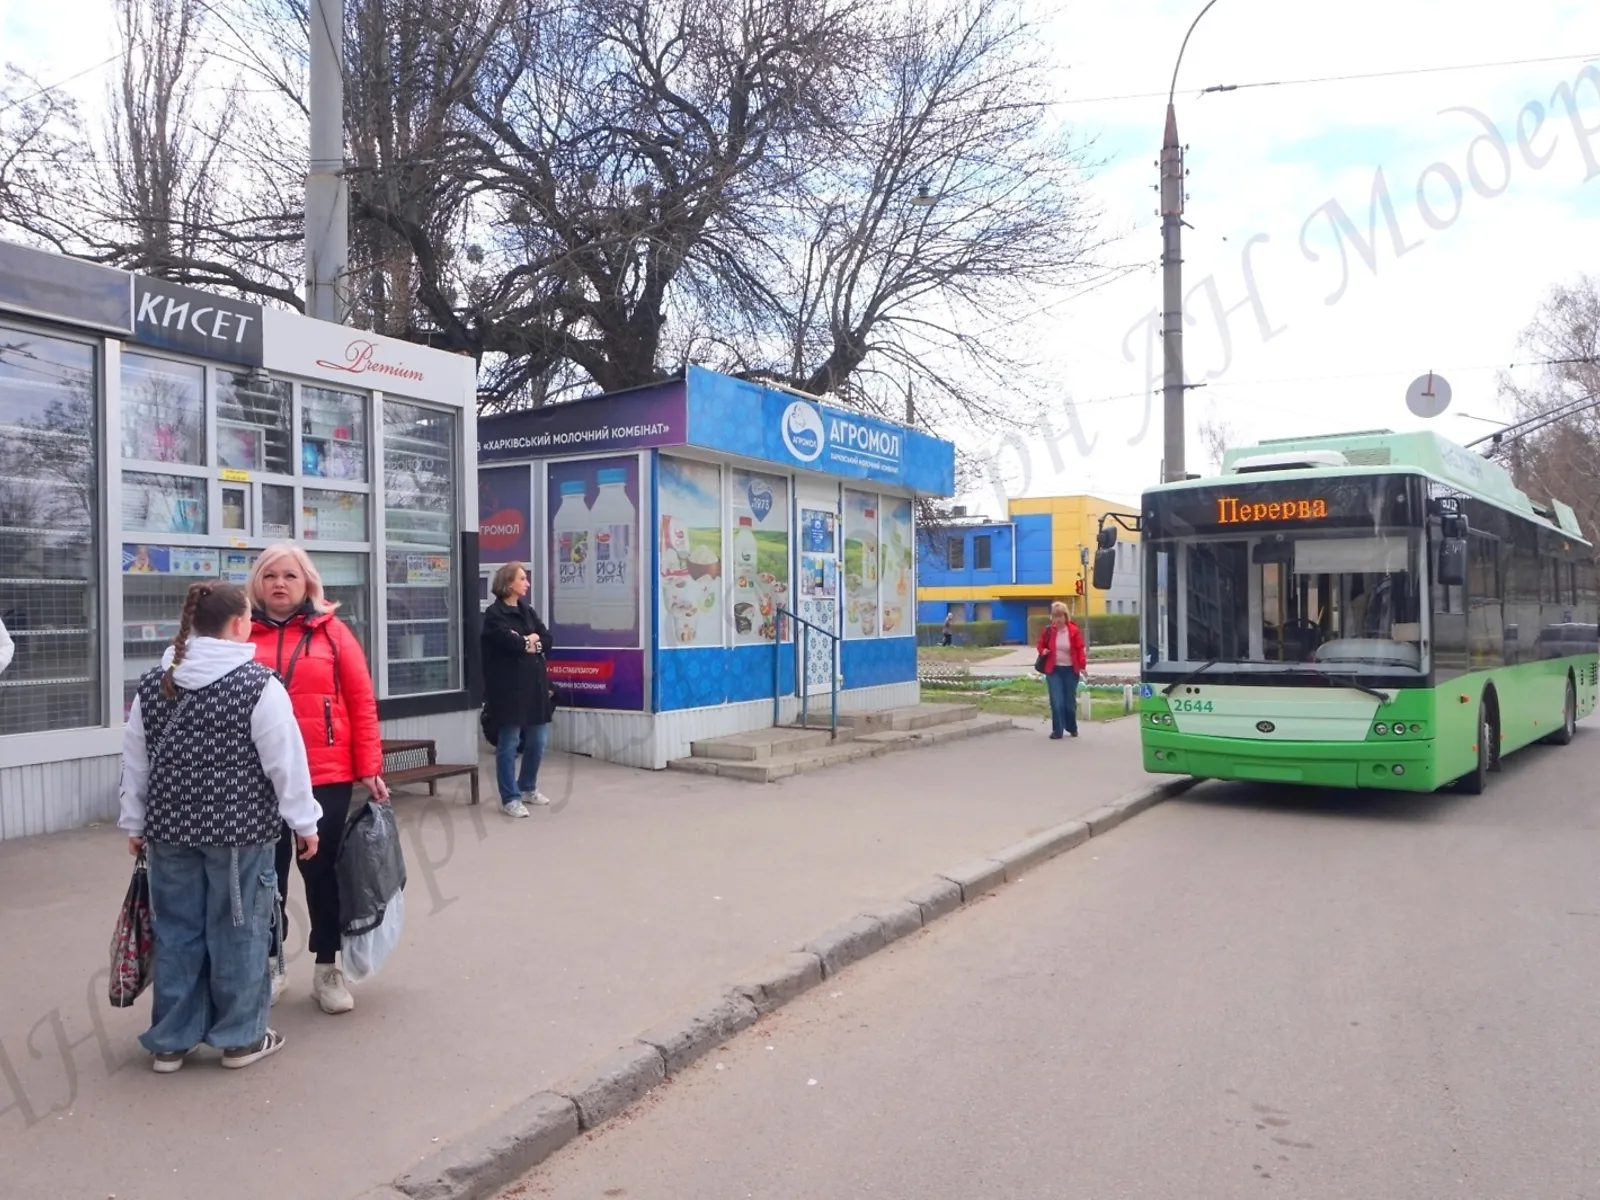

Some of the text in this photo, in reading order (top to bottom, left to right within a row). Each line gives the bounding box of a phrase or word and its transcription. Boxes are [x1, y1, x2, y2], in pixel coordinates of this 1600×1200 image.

[137, 291, 253, 343] КИСЕТ
[316, 340, 424, 382] Premium
[483, 432, 551, 450] «ХАРКІВСЬКИЙ
[553, 425, 609, 445] МОЛОЧНИЙ
[611, 422, 670, 439] КОМБІНАТ»
[792, 435, 818, 448] АГРОМОЛ
[829, 418, 900, 457] АГРОМОЛ
[1217, 496, 1328, 523] Перерва
[479, 523, 520, 536] ГРОМОЛ
[1174, 699, 1214, 712] 2644
